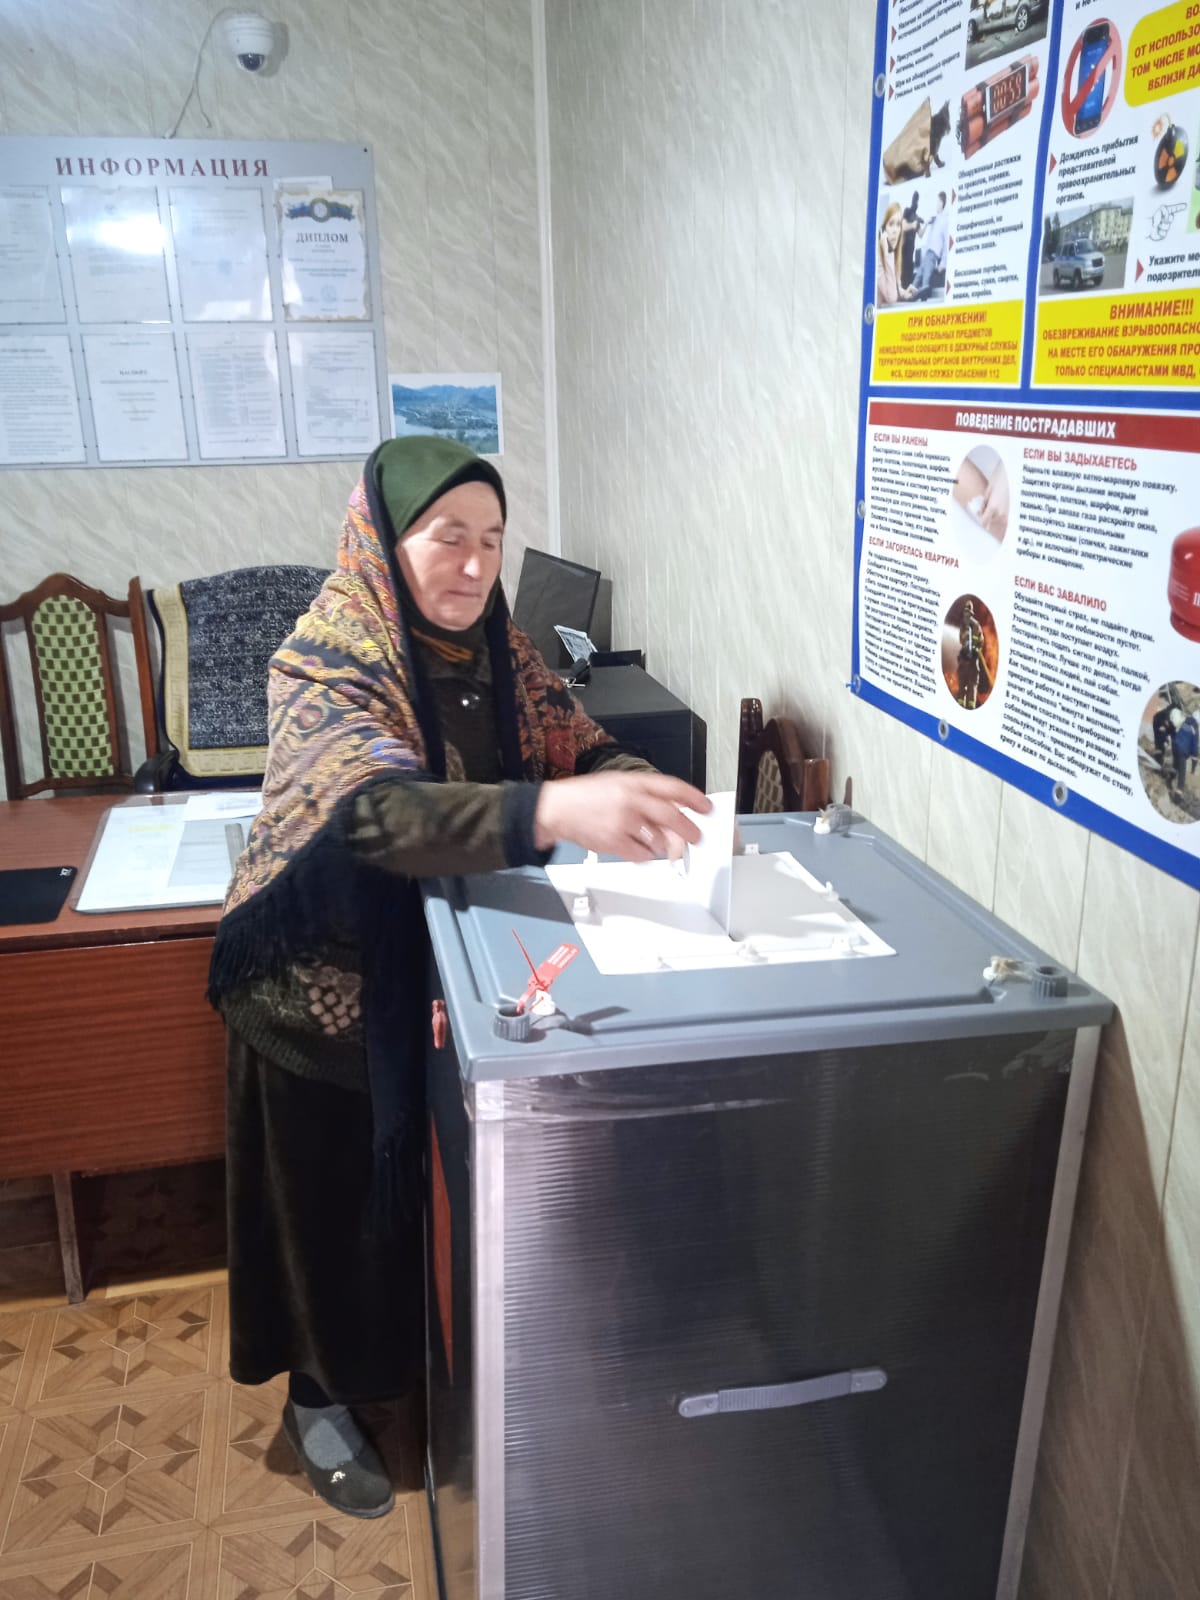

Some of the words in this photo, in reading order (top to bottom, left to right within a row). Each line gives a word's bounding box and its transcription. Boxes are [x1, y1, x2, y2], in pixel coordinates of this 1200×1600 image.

[1186, 3, 1200, 19] ВО
[1135, 44, 1147, 58] ОТ
[1131, 62, 1150, 78] ТОМ
[1154, 49, 1184, 70] ЧИСЛЕ
[1148, 69, 1185, 91] ВБЛИЗИ
[1060, 148, 1099, 165] Дождитесь
[1102, 136, 1138, 153] прибытия
[55, 157, 269, 179] ИНФОРМАЦИЯ
[1058, 154, 1116, 177] представителей
[1057, 166, 1136, 191] правоохранительных
[296, 232, 348, 243] ДИПЛОМ
[1149, 253, 1185, 266] Укажите
[1188, 253, 1200, 262] ме
[908, 317, 922, 327] ПРИ
[925, 311, 987, 326] ОБНАРУЖЕНИИ!
[1110, 298, 1194, 320] ВНИМАНИЕ!!!
[1043, 326, 1119, 340] ОБЕЗВРЕЖИВАНИЕ
[1060, 347, 1086, 358] МЕСТЕ
[1088, 346, 1104, 357] ЕГО
[1107, 344, 1177, 357] ОБНАРУЖЕНИЯ
[1180, 344, 1200, 355] ПРО
[1055, 365, 1085, 377] ТОЛЬКО
[1088, 365, 1168, 378] СПЕЦИАЛИСТАМИ
[1171, 364, 1196, 379] МВД,
[956, 412, 1012, 430] ПОВЕДЕНИЕ
[1015, 416, 1116, 438] ПОСТРАДАВШИХ
[874, 433, 890, 442] ЕСЛИ
[902, 435, 928, 447] РАНЕНЫ
[1024, 448, 1044, 460] ЕСЛИ
[1048, 450, 1062, 462] ВЫ
[1065, 452, 1137, 471] ЗАДЫХАЕТЕСЬ
[1022, 476, 1050, 487] Защитите
[1052, 482, 1074, 491] органы
[1107, 490, 1136, 500] мокрым
[1142, 481, 1178, 494] повязку.
[1090, 501, 1121, 513] шарфом,
[1123, 506, 1149, 517] другой
[1081, 513, 1096, 521] газа
[1098, 516, 1135, 528] раскройте
[1137, 523, 1157, 534] окна,
[869, 536, 884, 547] ЕСЛИ
[885, 540, 923, 558] ЗАГОРЕЛАСЬ
[925, 552, 959, 568] КВАРТИРА
[1080, 551, 1133, 568] электрические
[1109, 544, 1149, 558] зажигалки
[1015, 576, 1035, 590] ЕСЛИ
[1038, 582, 1055, 596] ВАС
[1057, 588, 1107, 611] ЗАВАЛИЛО
[1045, 602, 1067, 614] первый
[1068, 610, 1089, 622] страх,
[1101, 620, 1128, 634] падайте
[1130, 629, 1155, 642] духом.
[1061, 632, 1092, 647] поступает
[1094, 644, 1120, 657] воздух.
[1075, 625, 1115, 643] поблизости
[1117, 638, 1141, 651] пустот.
[1059, 654, 1080, 669] Лучше
[1093, 669, 1119, 684] делать,
[1120, 679, 1141, 692] когда
[1072, 649, 1096, 662] сигнал
[1097, 658, 1119, 671] рукой,
[1121, 666, 1150, 683] палкой,
